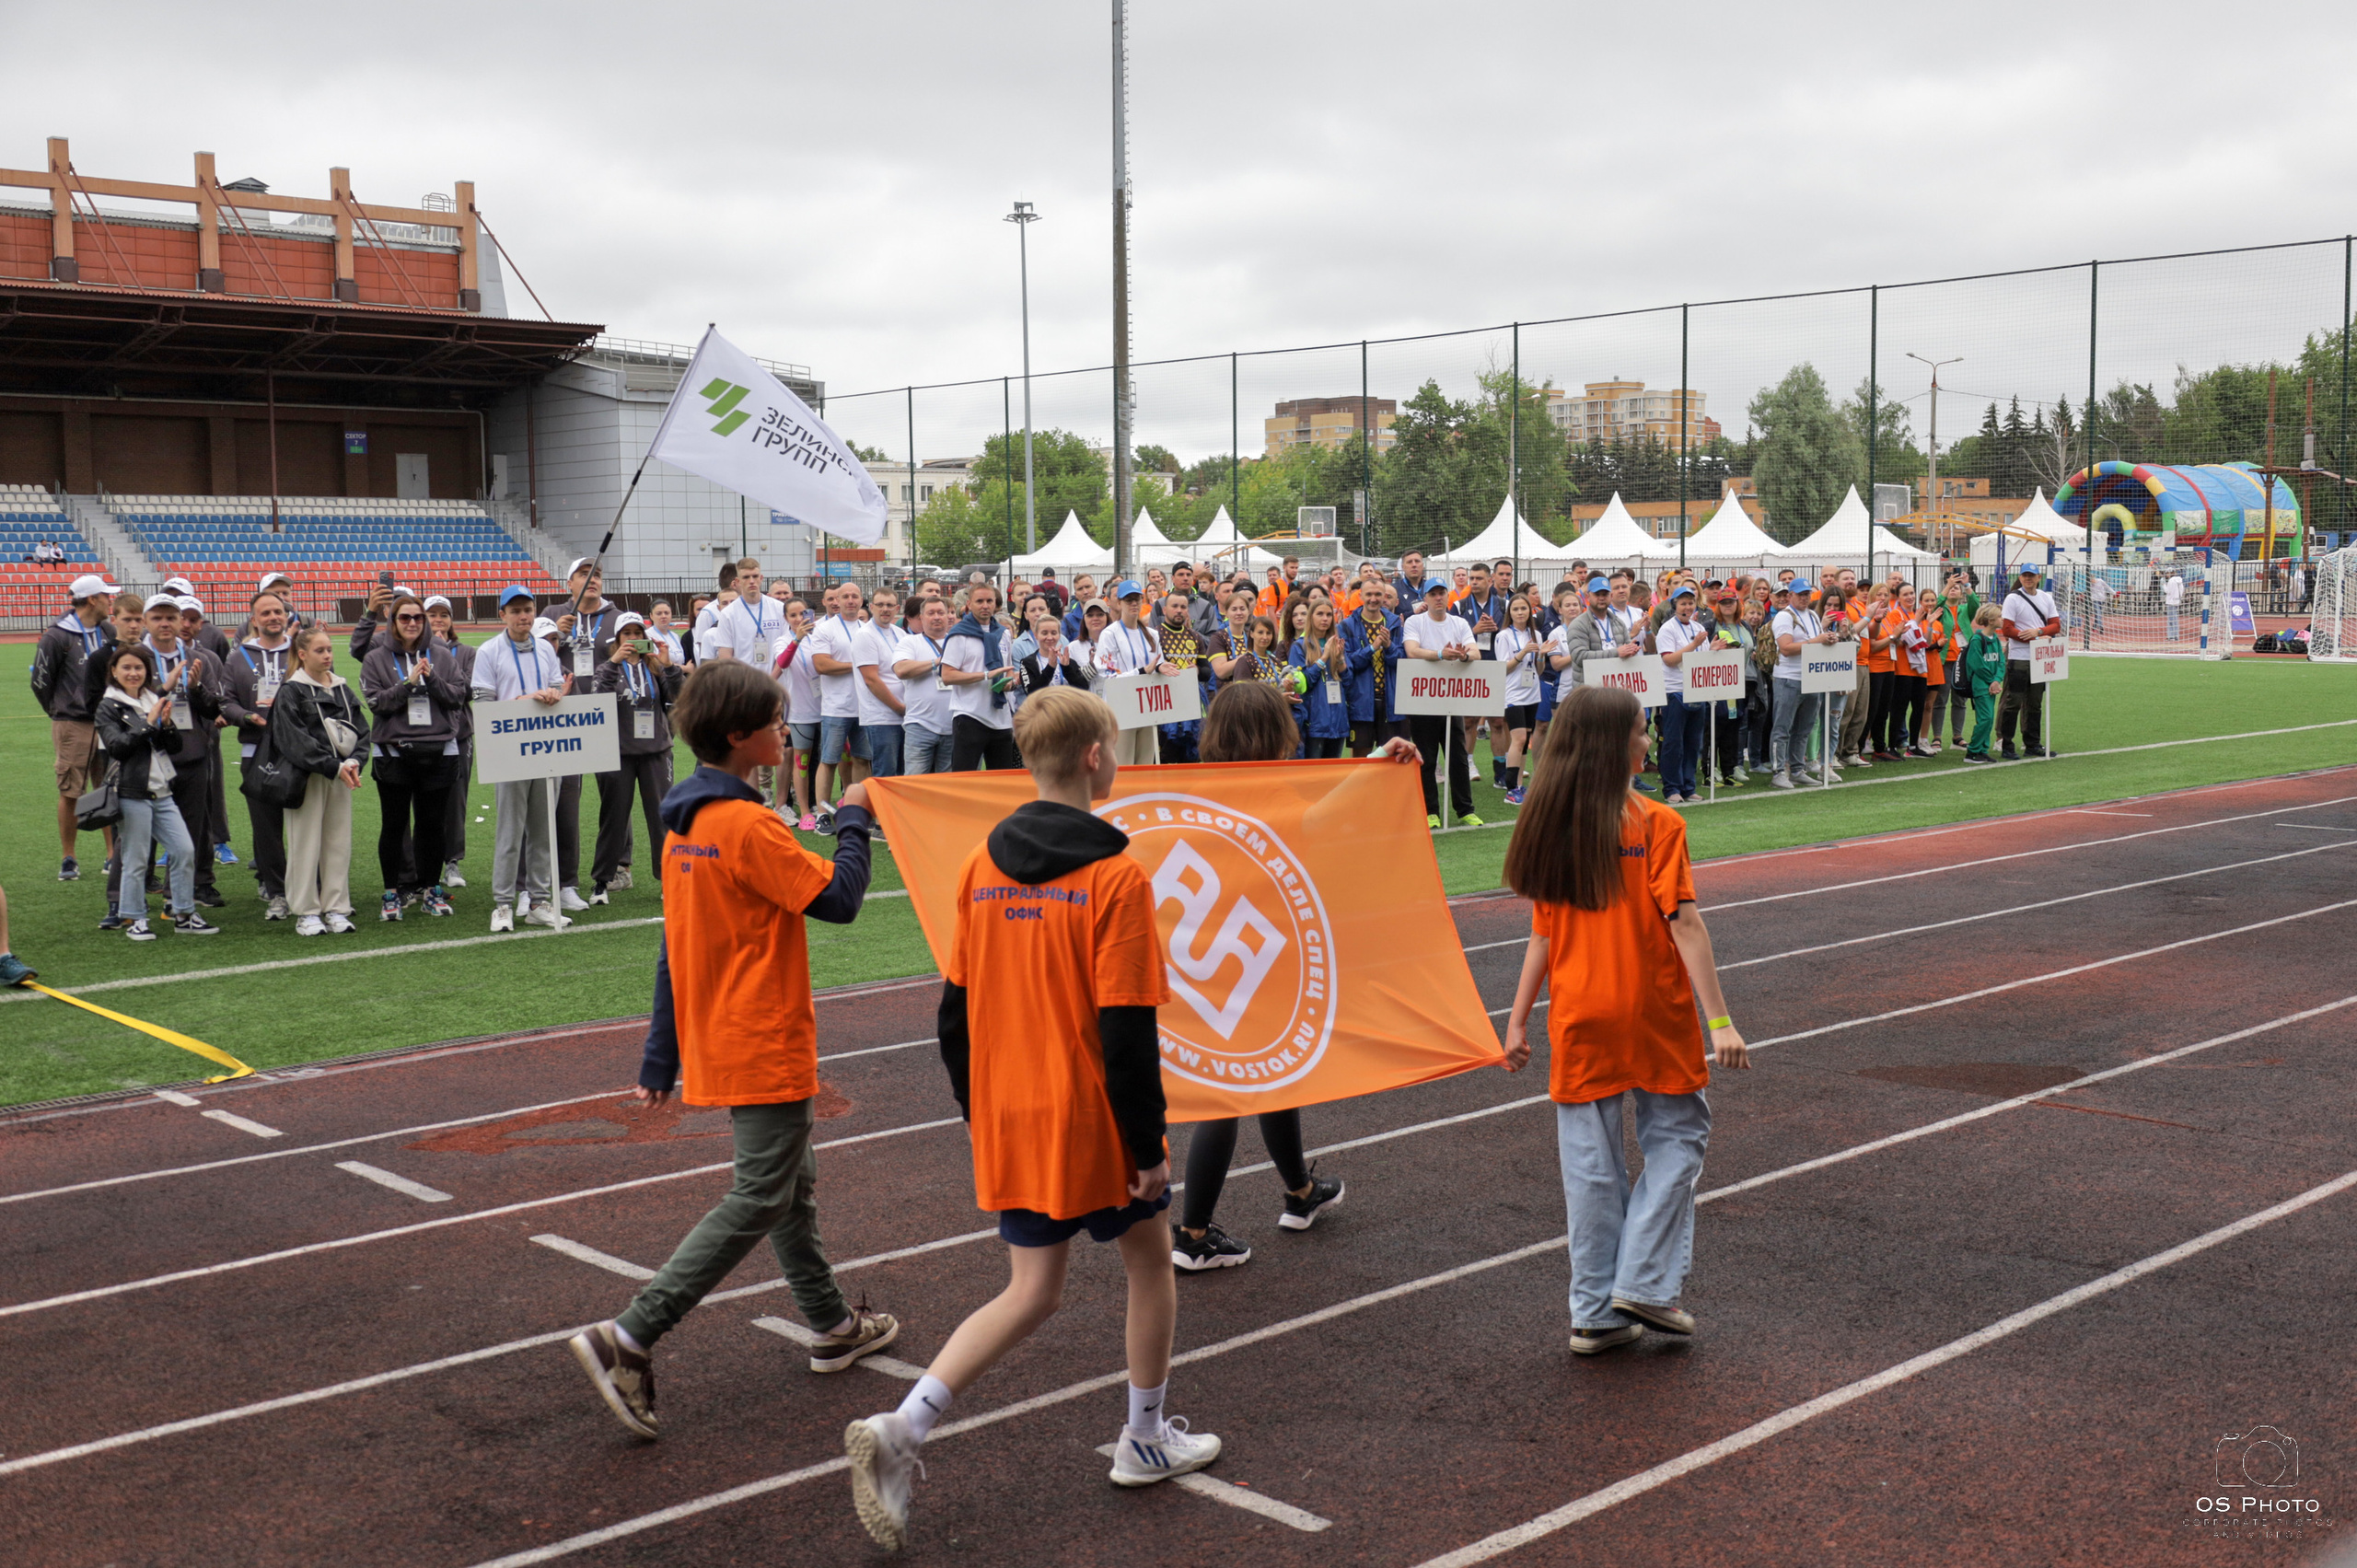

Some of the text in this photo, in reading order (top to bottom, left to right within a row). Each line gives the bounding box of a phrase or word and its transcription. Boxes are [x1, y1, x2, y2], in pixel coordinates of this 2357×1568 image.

[751, 425, 828, 474] ГРУПП
[1691, 664, 1738, 689] КЕМЕРОВО
[1808, 660, 1852, 673] РЕГИОНЫ
[1411, 678, 1490, 698] ЯРОСЛАВЛЬ
[1602, 671, 1647, 693] КАЗАНЬ
[1136, 684, 1173, 714] ТУЛА
[491, 707, 605, 734] ЗЕЛИНСКИЙ
[520, 738, 582, 756] ГРУПП
[973, 886, 1088, 906] ЦЕНТРАЛЬНЫЙ
[1155, 807, 1324, 1000] В СВОЕМ ДЕЛЕ СПЕЦ
[1005, 906, 1043, 920] ОФИС
[1157, 1021, 1316, 1079] WW.VOSTOK.RU
